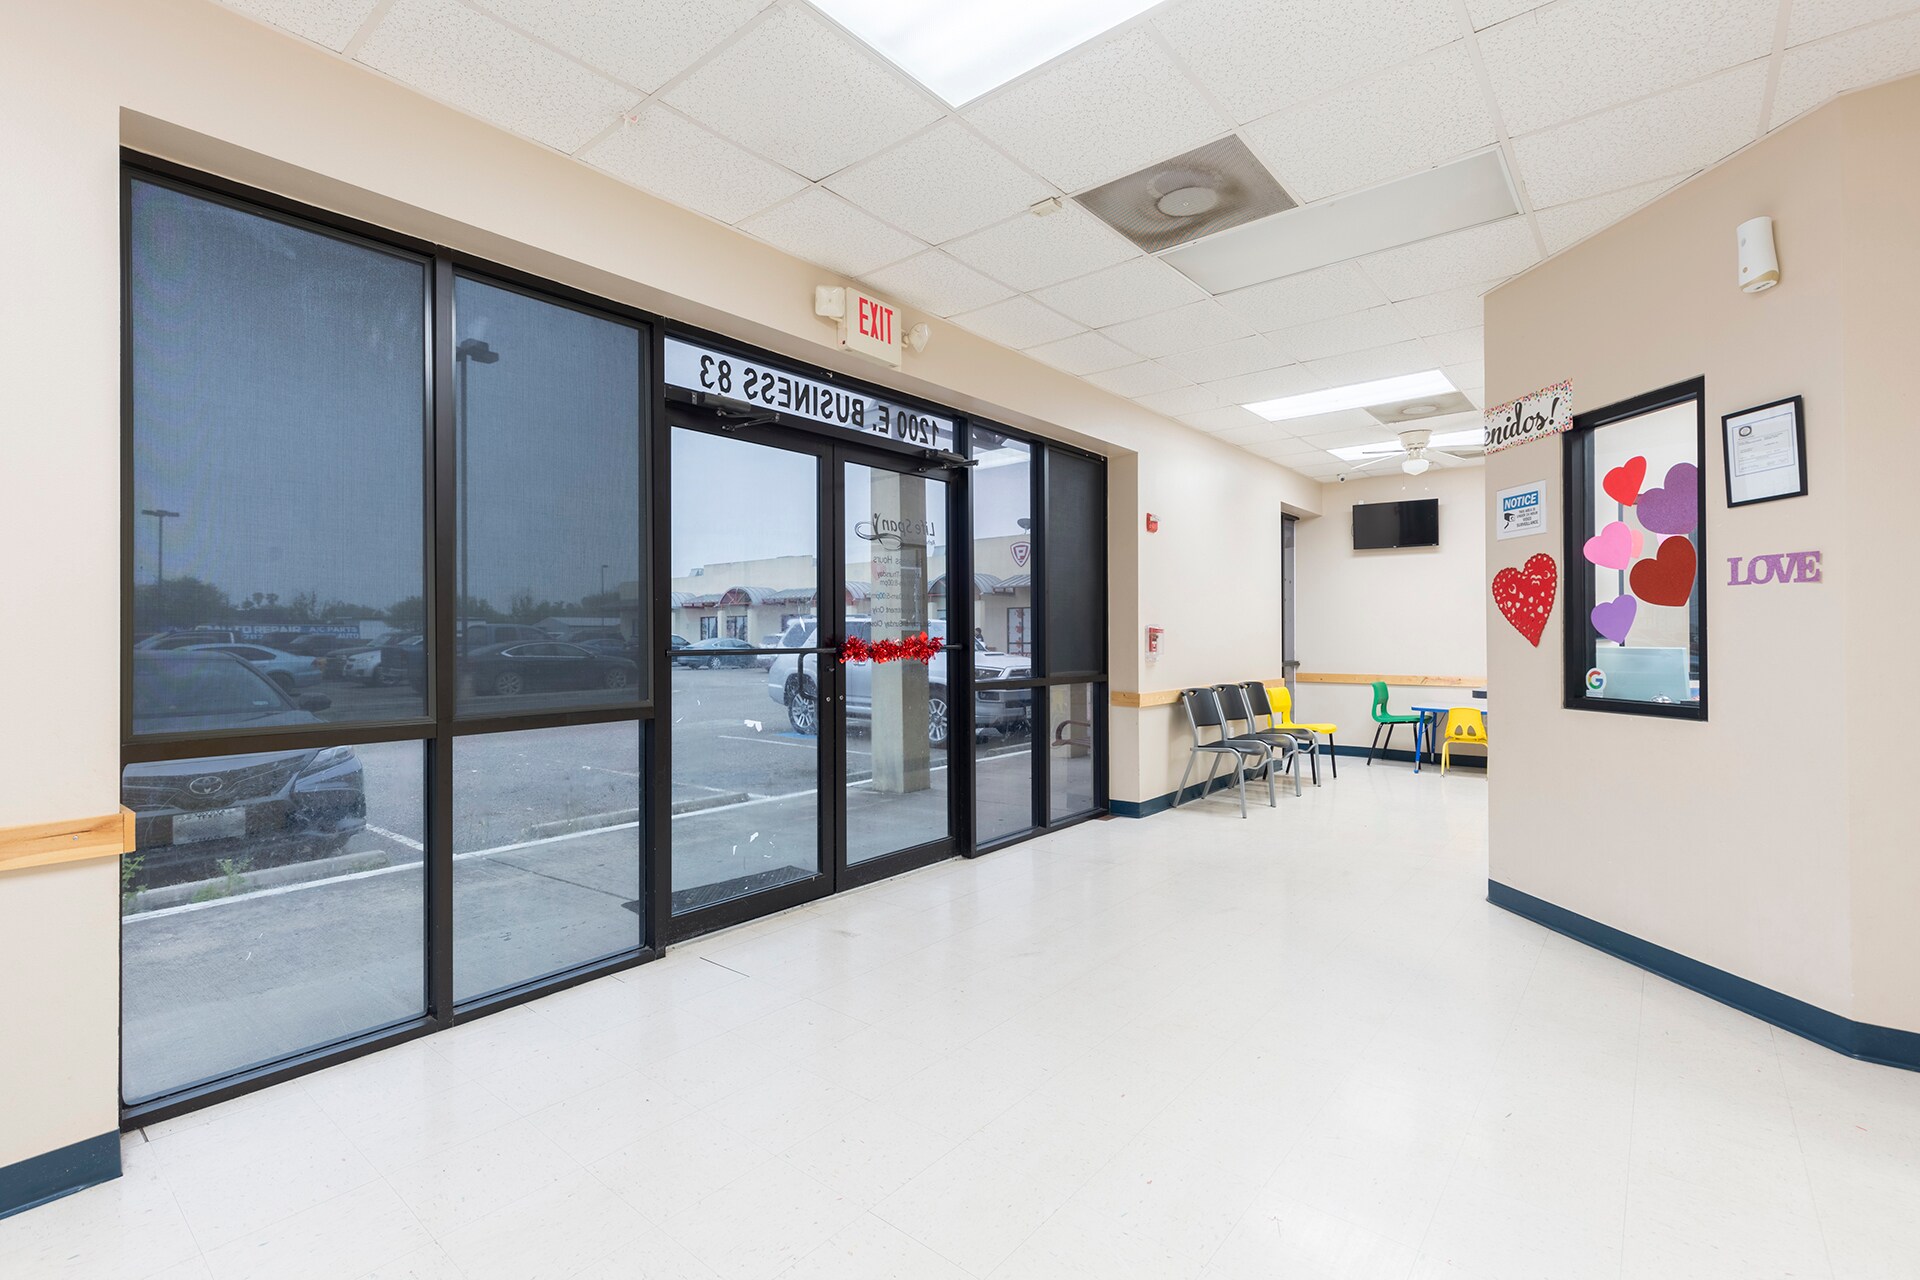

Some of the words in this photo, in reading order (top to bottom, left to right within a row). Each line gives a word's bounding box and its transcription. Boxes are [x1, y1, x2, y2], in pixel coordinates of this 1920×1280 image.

[858, 296, 894, 345] EXIT
[1484, 396, 1561, 447] enidos!
[1504, 492, 1538, 510] NOTICE
[1726, 550, 1821, 586] LOVE
[253, 624, 303, 633] REPAIR
[326, 625, 358, 633] PARTS
